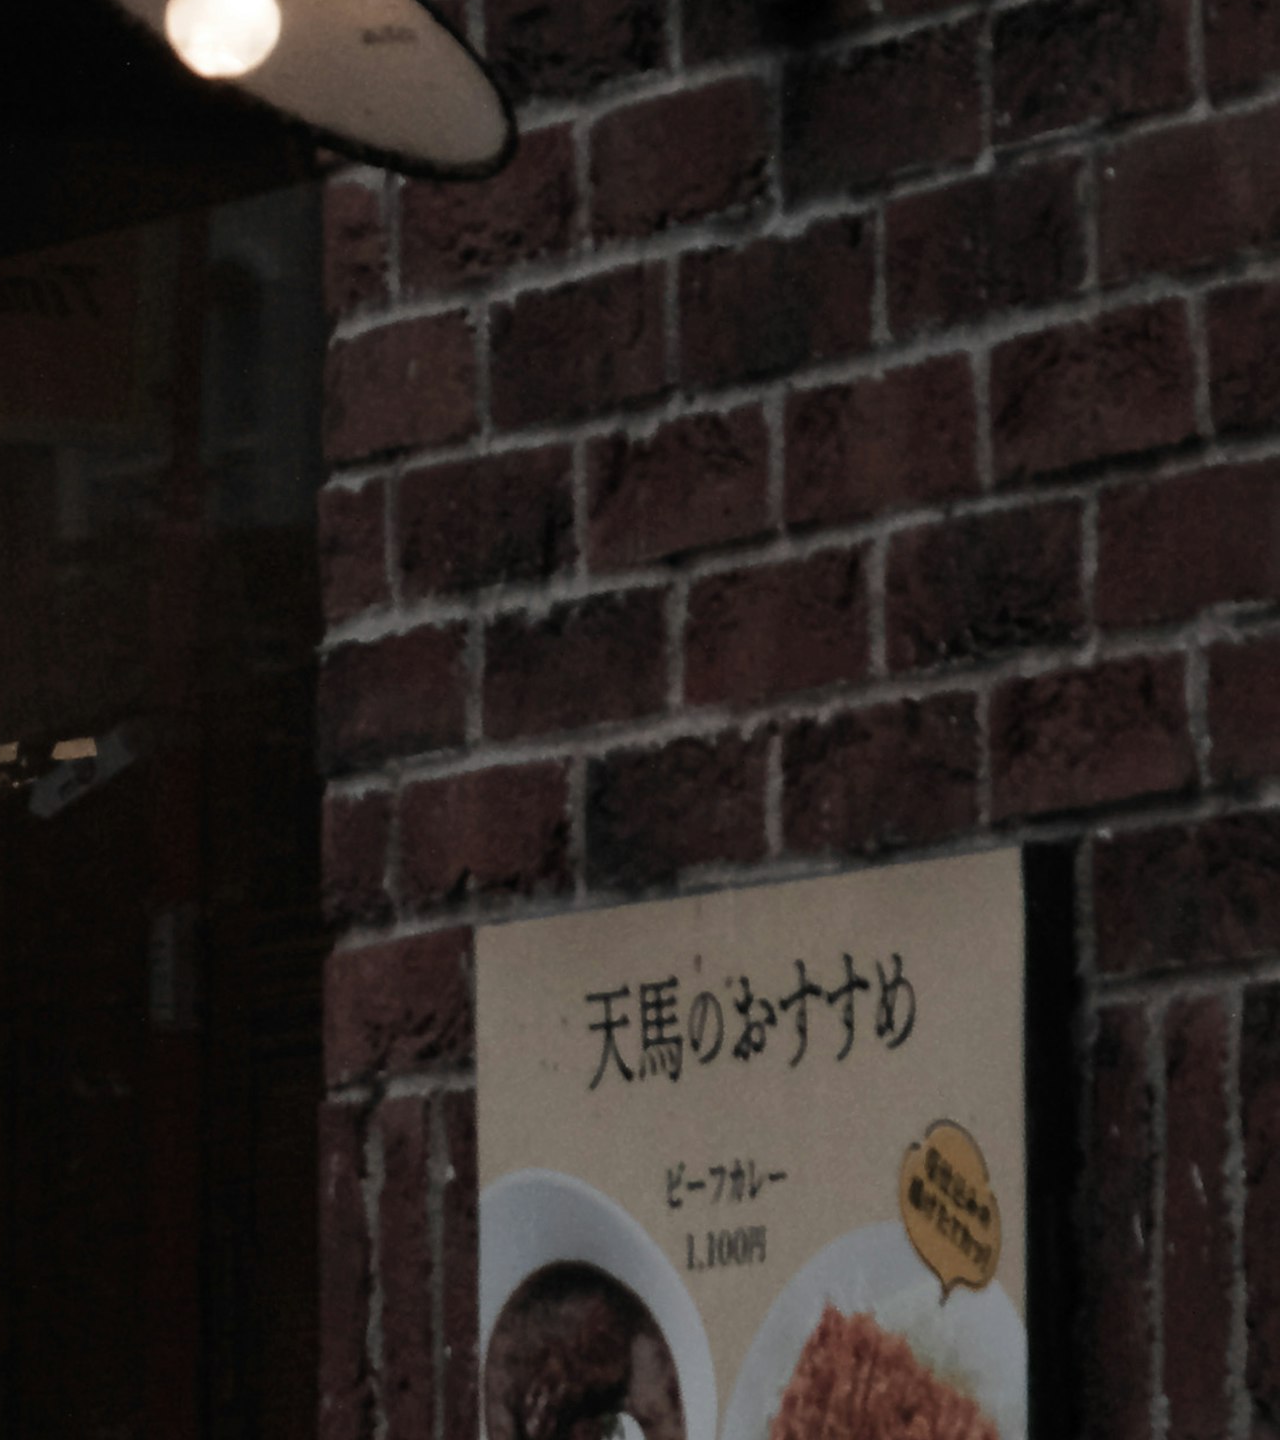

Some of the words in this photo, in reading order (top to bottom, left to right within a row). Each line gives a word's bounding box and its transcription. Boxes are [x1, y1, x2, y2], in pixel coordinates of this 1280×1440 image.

[585, 951, 916, 1092] 天馬のおすすめ
[665, 1158, 787, 1210] ビーフカレー
